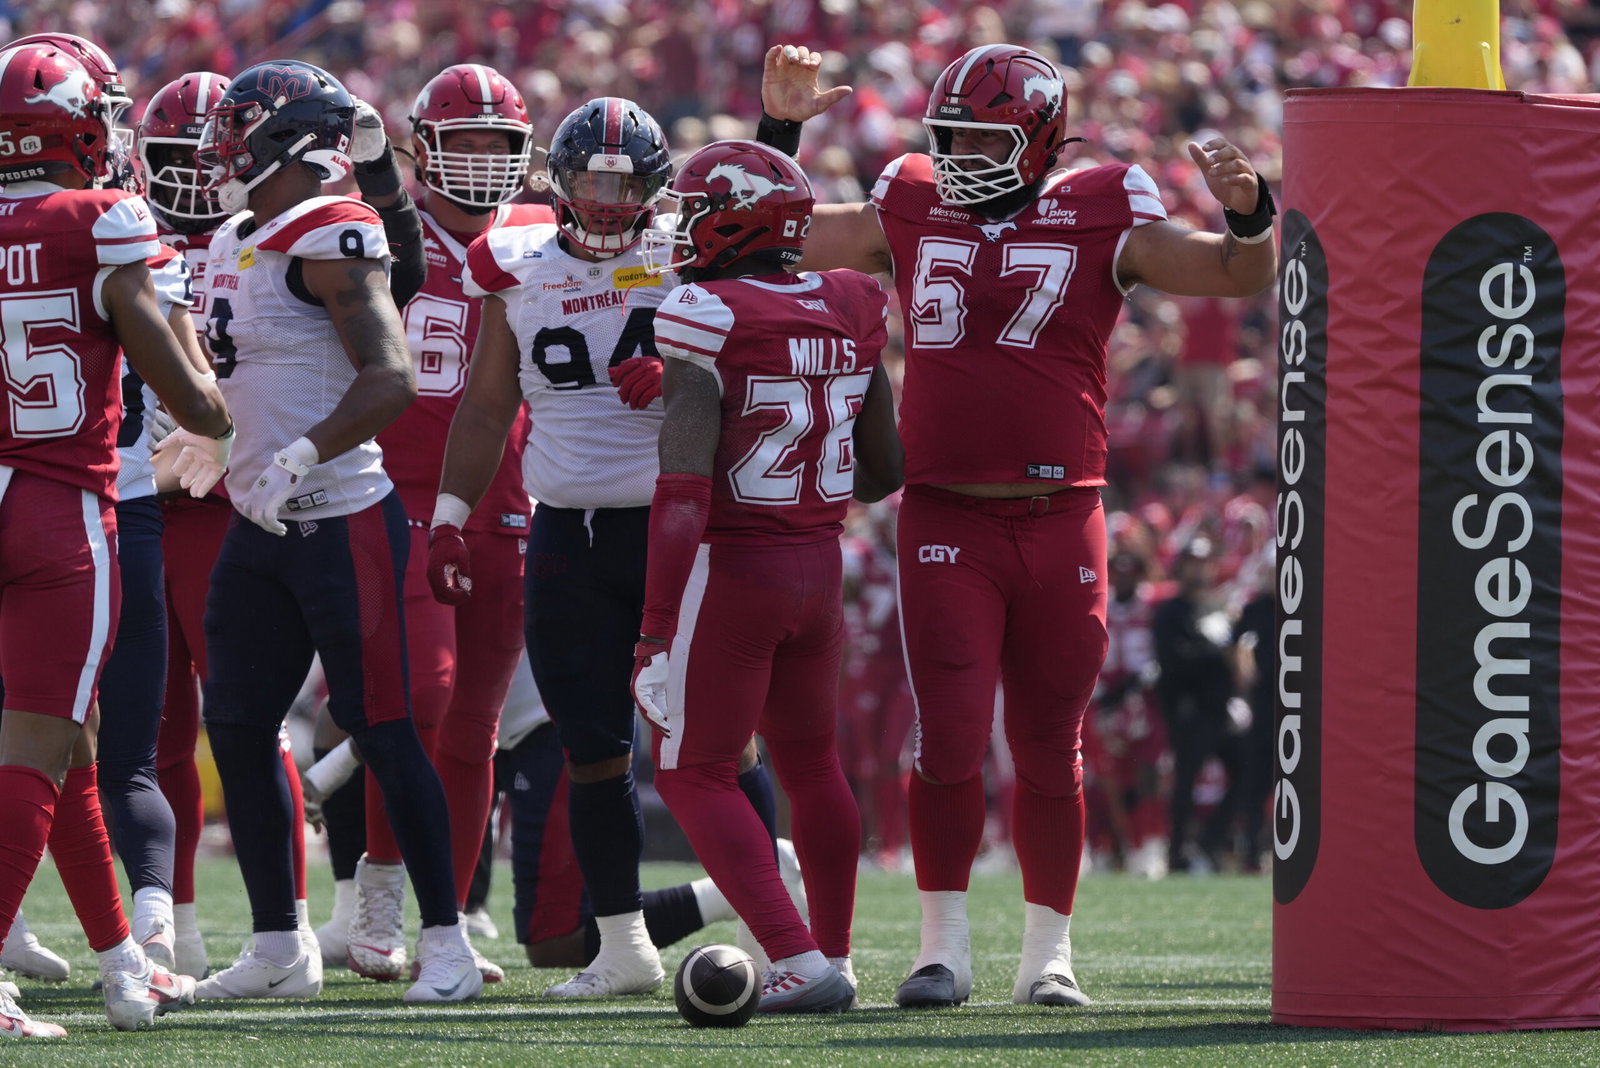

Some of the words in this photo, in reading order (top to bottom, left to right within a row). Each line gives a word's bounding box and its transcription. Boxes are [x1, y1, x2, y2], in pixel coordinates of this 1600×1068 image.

[23, 140, 39, 151] CFL
[0, 167, 45, 181] PEDERS
[929, 206, 970, 221] Western
[1031, 216, 1077, 225] alberta
[1048, 208, 1077, 217] play
[339, 228, 365, 257] 9
[425, 250, 447, 263] stern
[589, 269, 600, 277] LCF
[543, 280, 583, 291] Freedom
[910, 236, 1078, 349] 57
[561, 290, 624, 315] MONTRÉAL
[788, 338, 856, 376] MILLS
[727, 366, 874, 506] 26
[918, 545, 960, 564] CGY
[1273, 258, 1308, 860] GameSense
[1448, 262, 1536, 865] GameSense
